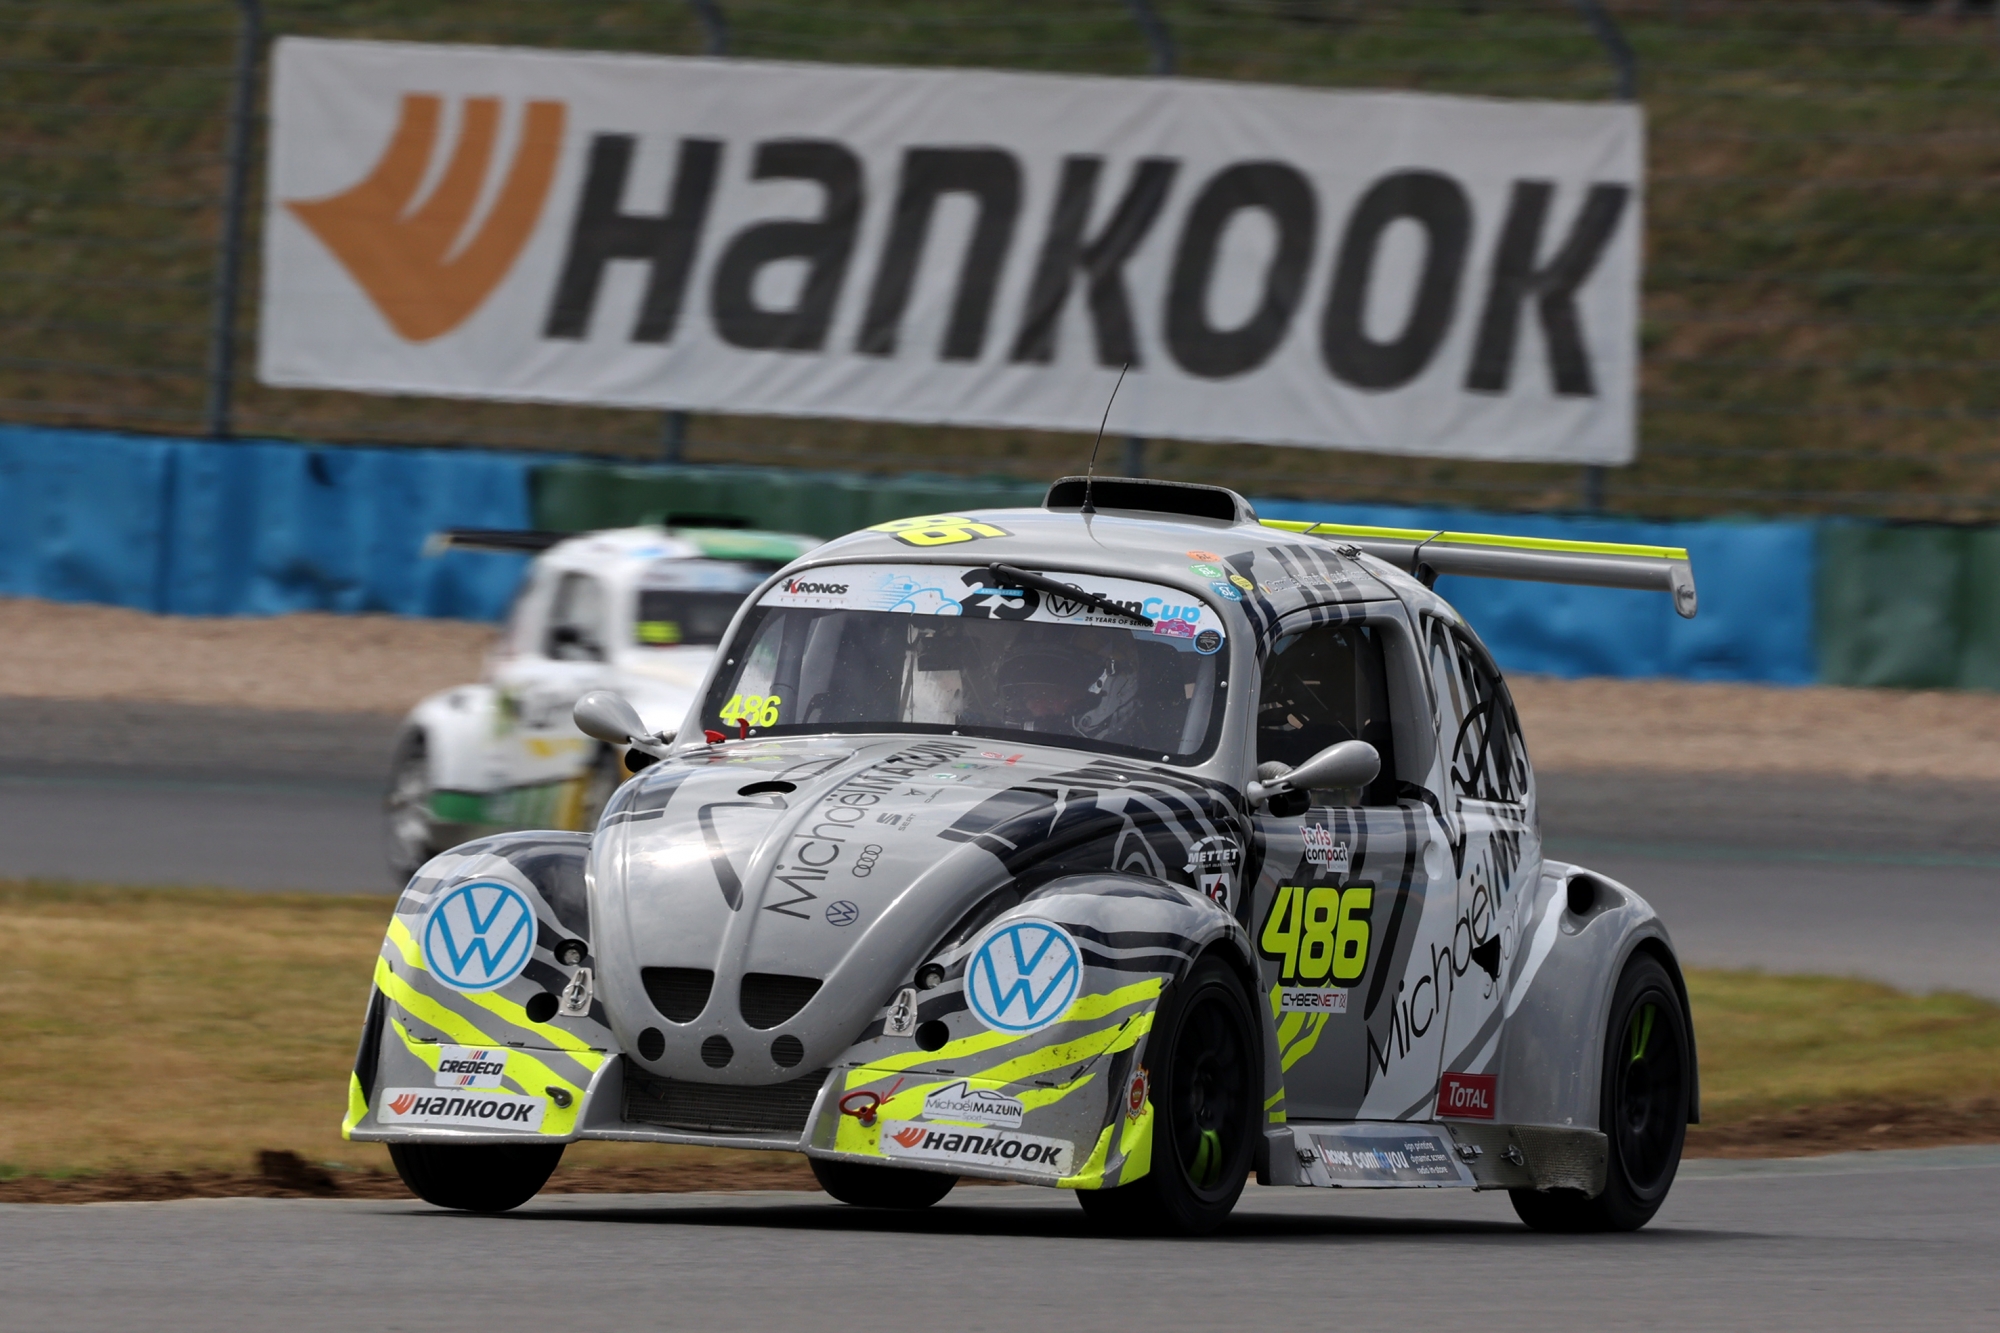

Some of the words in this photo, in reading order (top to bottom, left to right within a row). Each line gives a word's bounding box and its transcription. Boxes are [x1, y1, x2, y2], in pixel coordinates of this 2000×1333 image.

[543, 133, 1631, 396] HANKOOK
[784, 575, 849, 594] KRONOS
[719, 694, 781, 728] 486
[1187, 848, 1239, 863] METTET
[1306, 841, 1348, 869] compact
[1261, 886, 1373, 981] 486
[1282, 993, 1339, 1007] CYBERNET
[438, 1060, 503, 1076] CREDECO
[1449, 1081, 1489, 1109] TOTAL
[411, 1096, 535, 1122] HANKOOK
[962, 1113, 982, 1122] Sport
[922, 1131, 1063, 1166] HANKOOK
